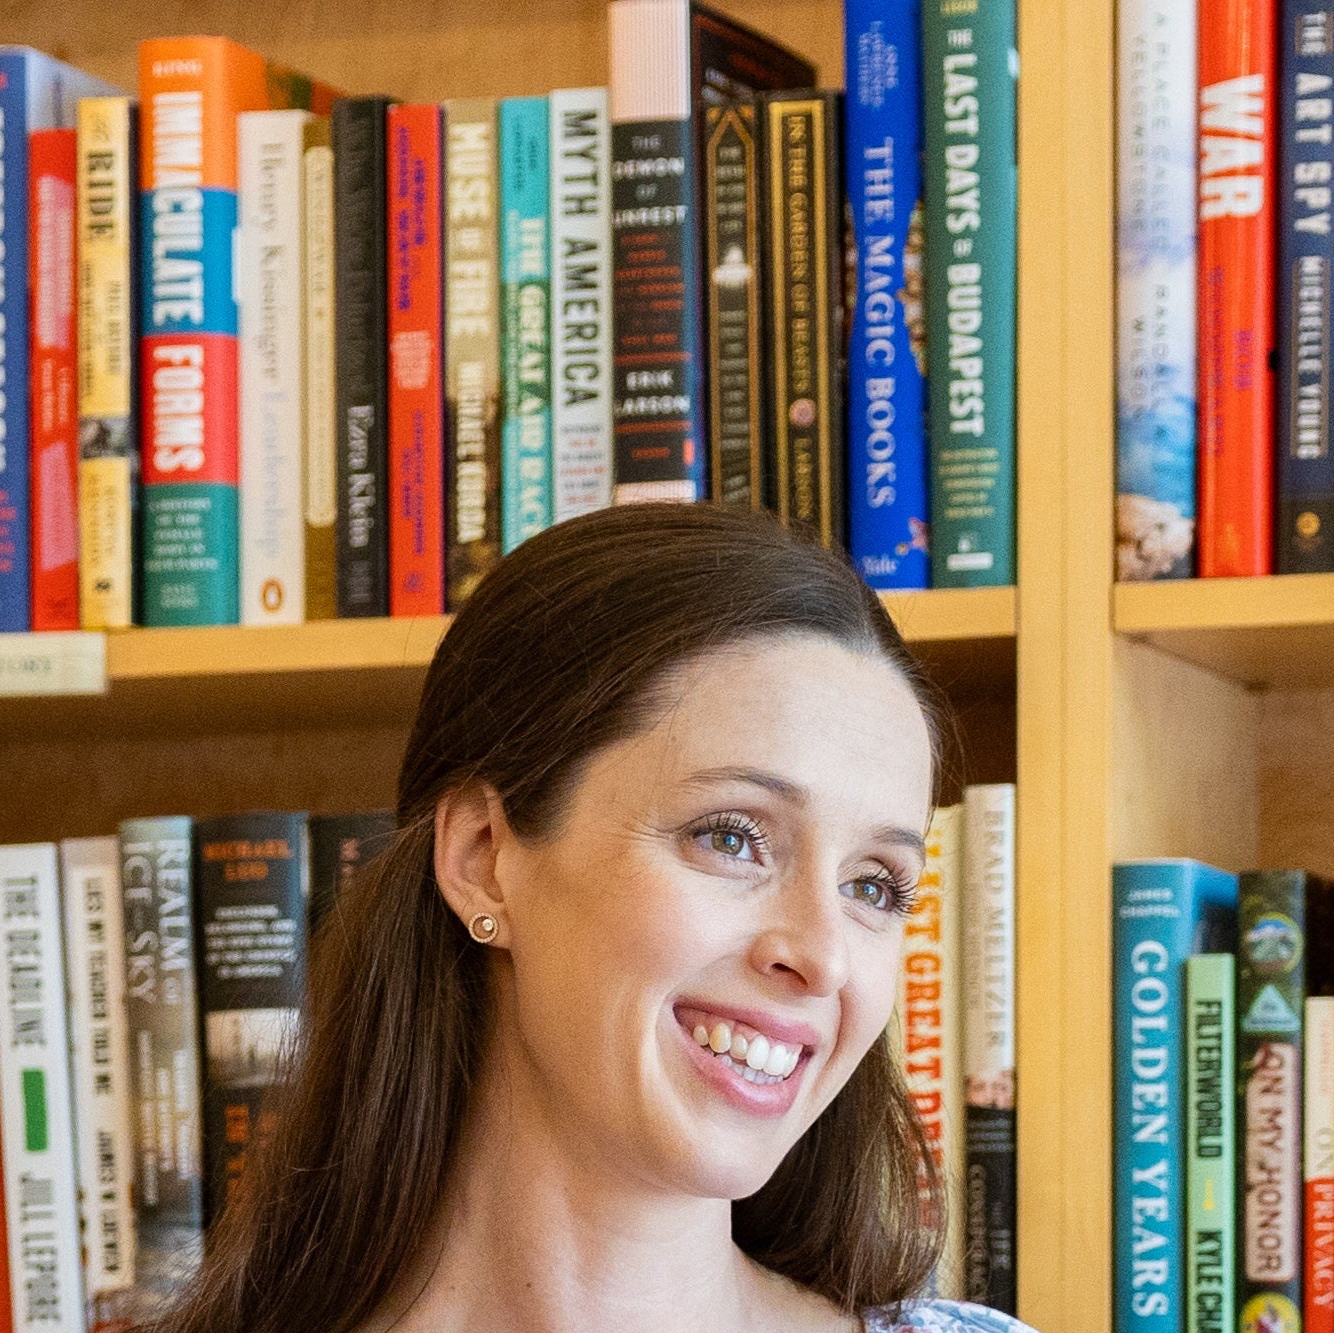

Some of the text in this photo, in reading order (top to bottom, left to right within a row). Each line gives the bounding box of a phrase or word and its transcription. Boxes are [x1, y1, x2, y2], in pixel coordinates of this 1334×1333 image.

[153, 91, 205, 325] IMMACULATE
[1200, 74, 1266, 220] WAR
[563, 109, 599, 408] MYTH AMERICA
[865, 136, 897, 508] THE MAGIC BOOKS
[942, 53, 983, 436] LAST DAYS BUDAPEST
[153, 345, 205, 472] FORMS
[1, 876, 39, 923] THE
[1131, 938, 1170, 1137] GOLDEN
[1195, 999, 1223, 1158] FILTERWORLD
[19, 1171, 55, 1230] JILL
[1131, 1157, 1169, 1318] YEARS
[1247, 1046, 1292, 1278] ON MY HONOR
[21, 1238, 60, 1324] LEPORE
